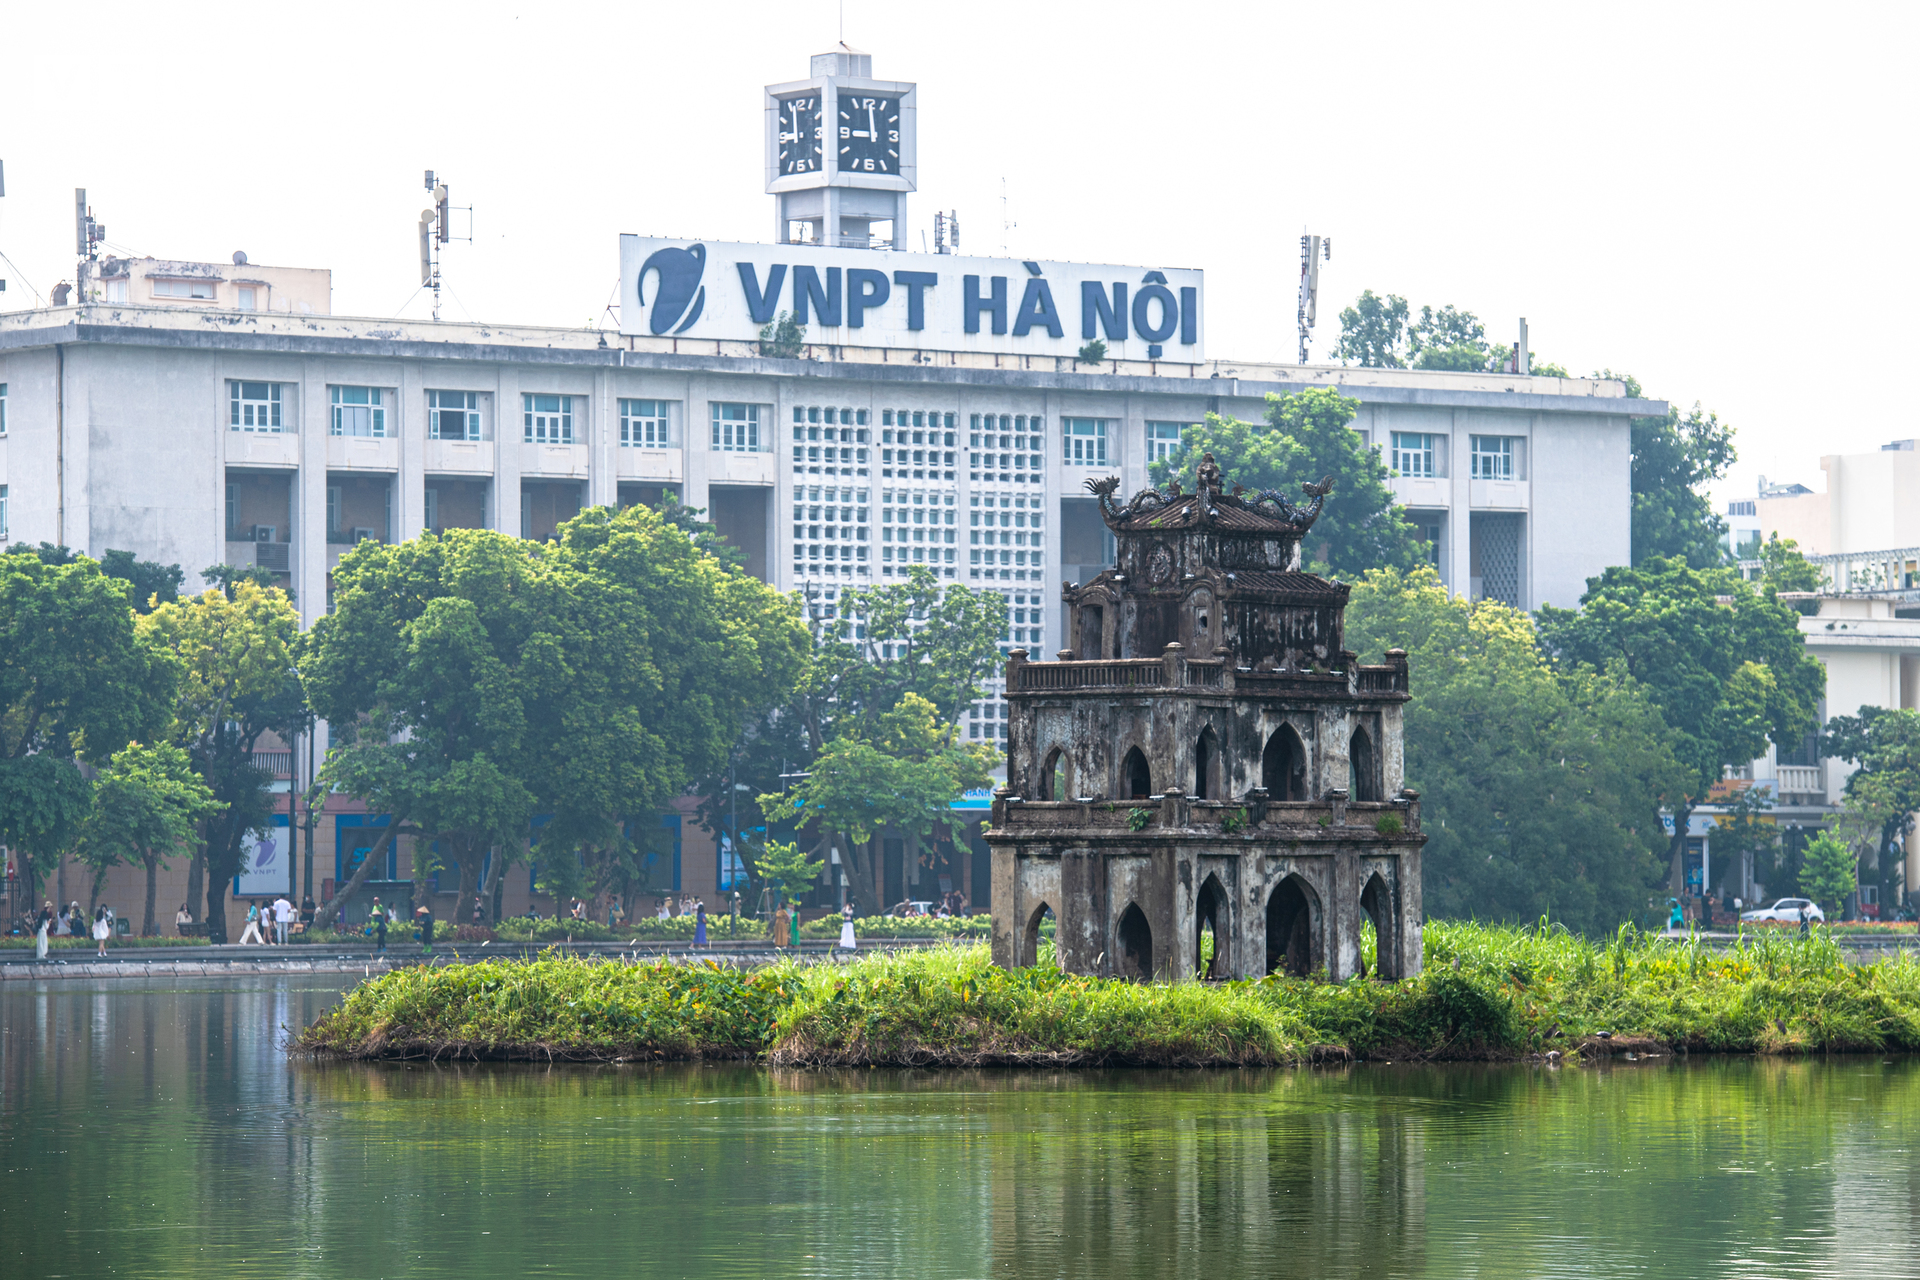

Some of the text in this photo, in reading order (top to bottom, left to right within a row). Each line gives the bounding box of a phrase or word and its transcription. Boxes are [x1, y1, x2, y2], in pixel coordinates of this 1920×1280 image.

[814, 127, 822, 140] 3
[839, 126, 850, 139] 9
[888, 130, 899, 143] 3
[797, 160, 806, 172] 6
[863, 158, 875, 171] 6
[737, 263, 938, 331] VNPT
[964, 262, 1065, 338] HÀ
